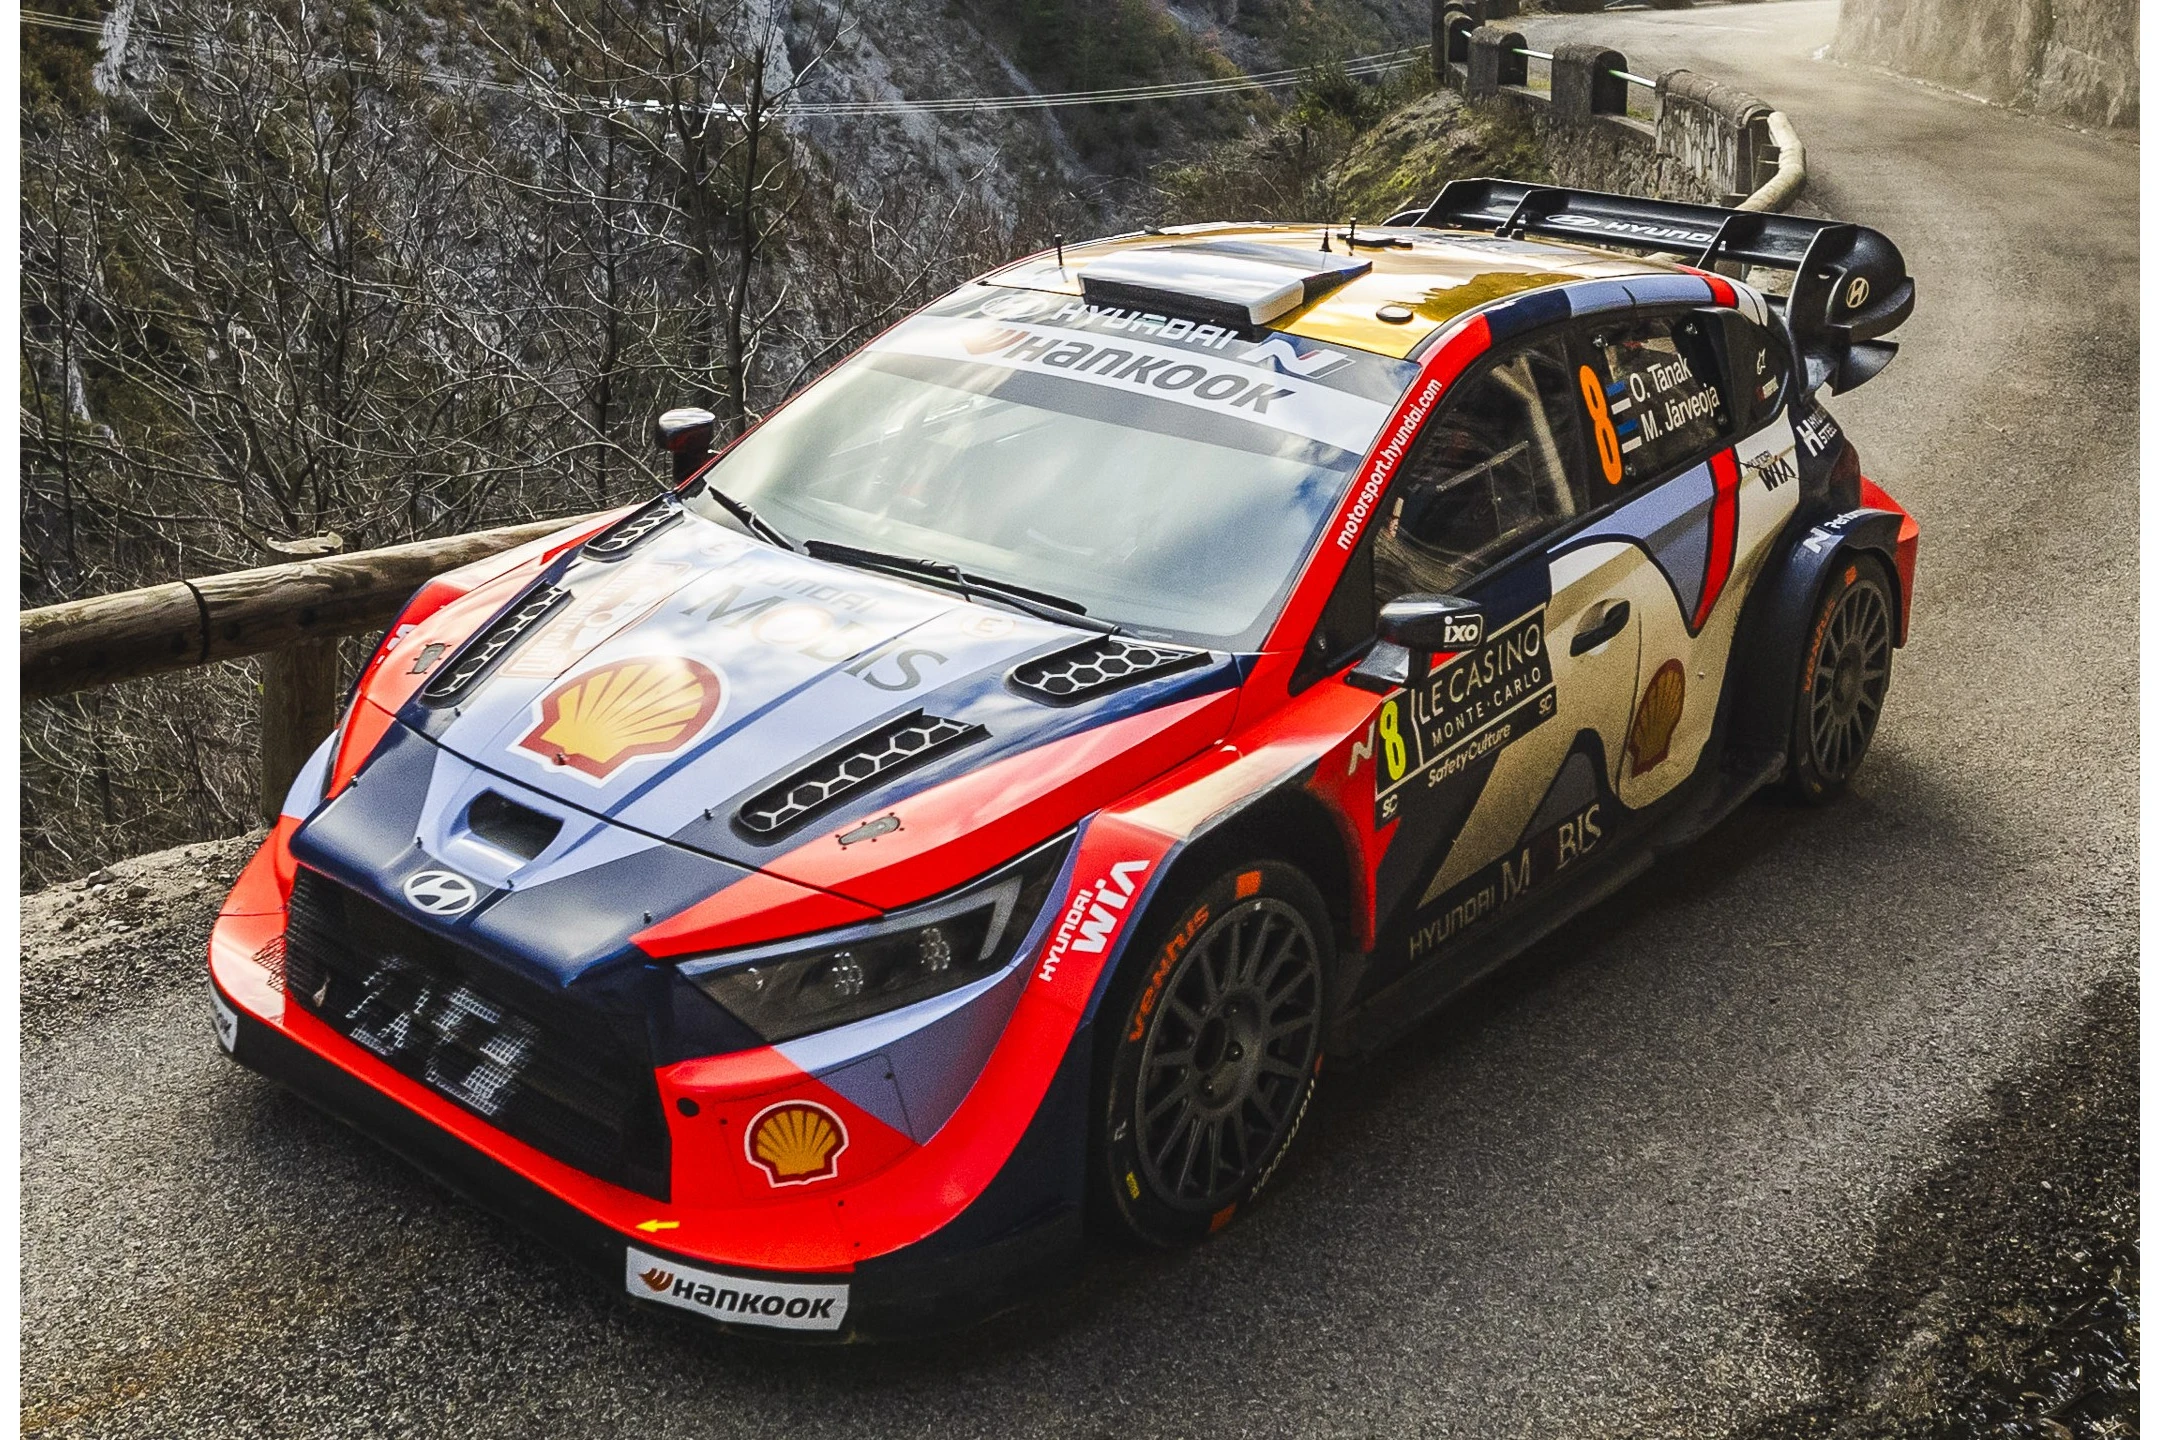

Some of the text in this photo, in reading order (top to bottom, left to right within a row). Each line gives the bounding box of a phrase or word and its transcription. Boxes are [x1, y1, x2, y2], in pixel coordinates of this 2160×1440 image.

[1605, 221, 1717, 243] HYUND
[1629, 372, 1651, 402] O.
[1640, 410, 1663, 442] M.
[1664, 383, 1720, 432] Järveoja
[1580, 364, 1622, 485] 8
[1336, 378, 1443, 551] motorsport.hyundai.com
[727, 562, 882, 614] YUNDAI
[1443, 616, 1478, 642] ixo
[1418, 623, 1540, 725] LE CASINO
[1380, 700, 1406, 781] 8
[1427, 723, 1512, 788] SafetyCulture
[1409, 804, 1602, 961] HYUNDAI MBIS
[1038, 888, 1094, 983] HYUNDAI
